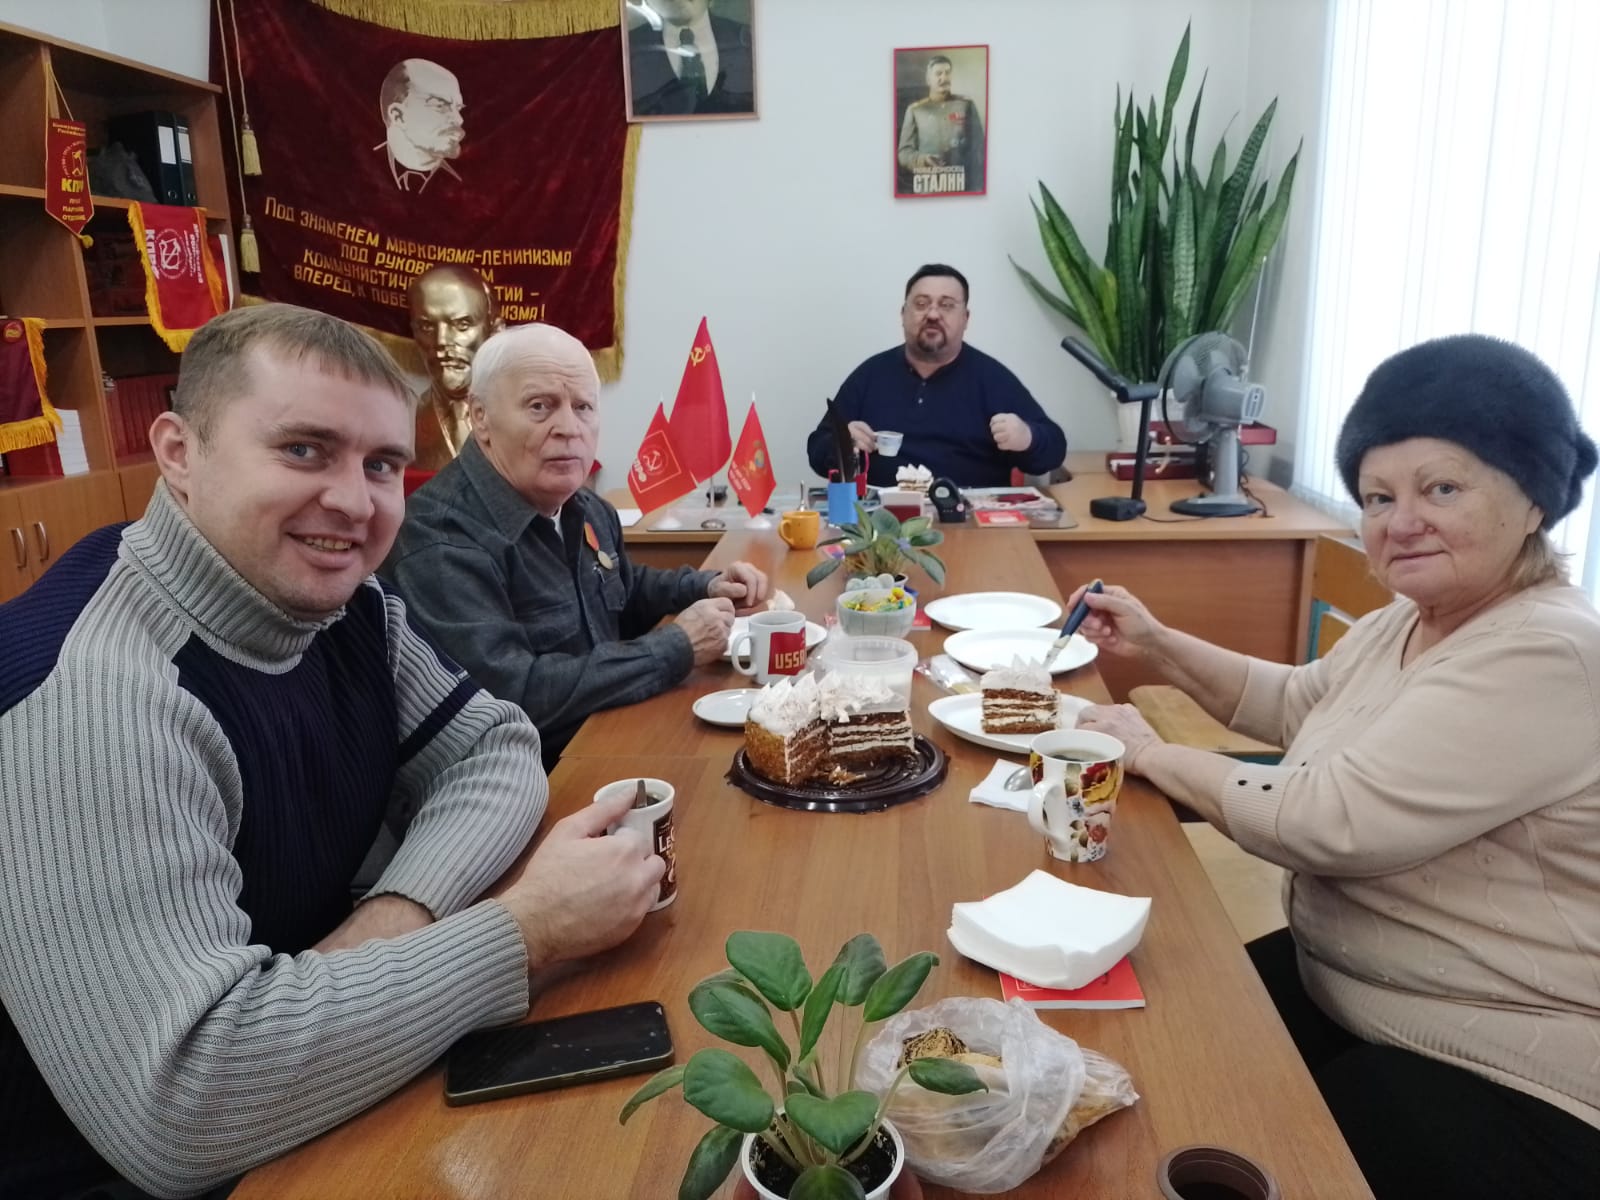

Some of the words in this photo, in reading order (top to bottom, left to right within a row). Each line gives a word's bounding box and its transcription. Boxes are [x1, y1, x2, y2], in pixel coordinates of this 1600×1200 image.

[913, 173, 966, 194] СТАЛИН
[300, 211, 380, 247] ЗНАМЕНЕМ
[386, 237, 572, 266] МАРКСИЗМА-ЛЕНИНИЗМА
[341, 243, 369, 264] ПОД
[371, 288, 409, 309] ПОБЕ
[501, 304, 545, 321] ИЗМА!
[494, 286, 523, 302] ТИИ
